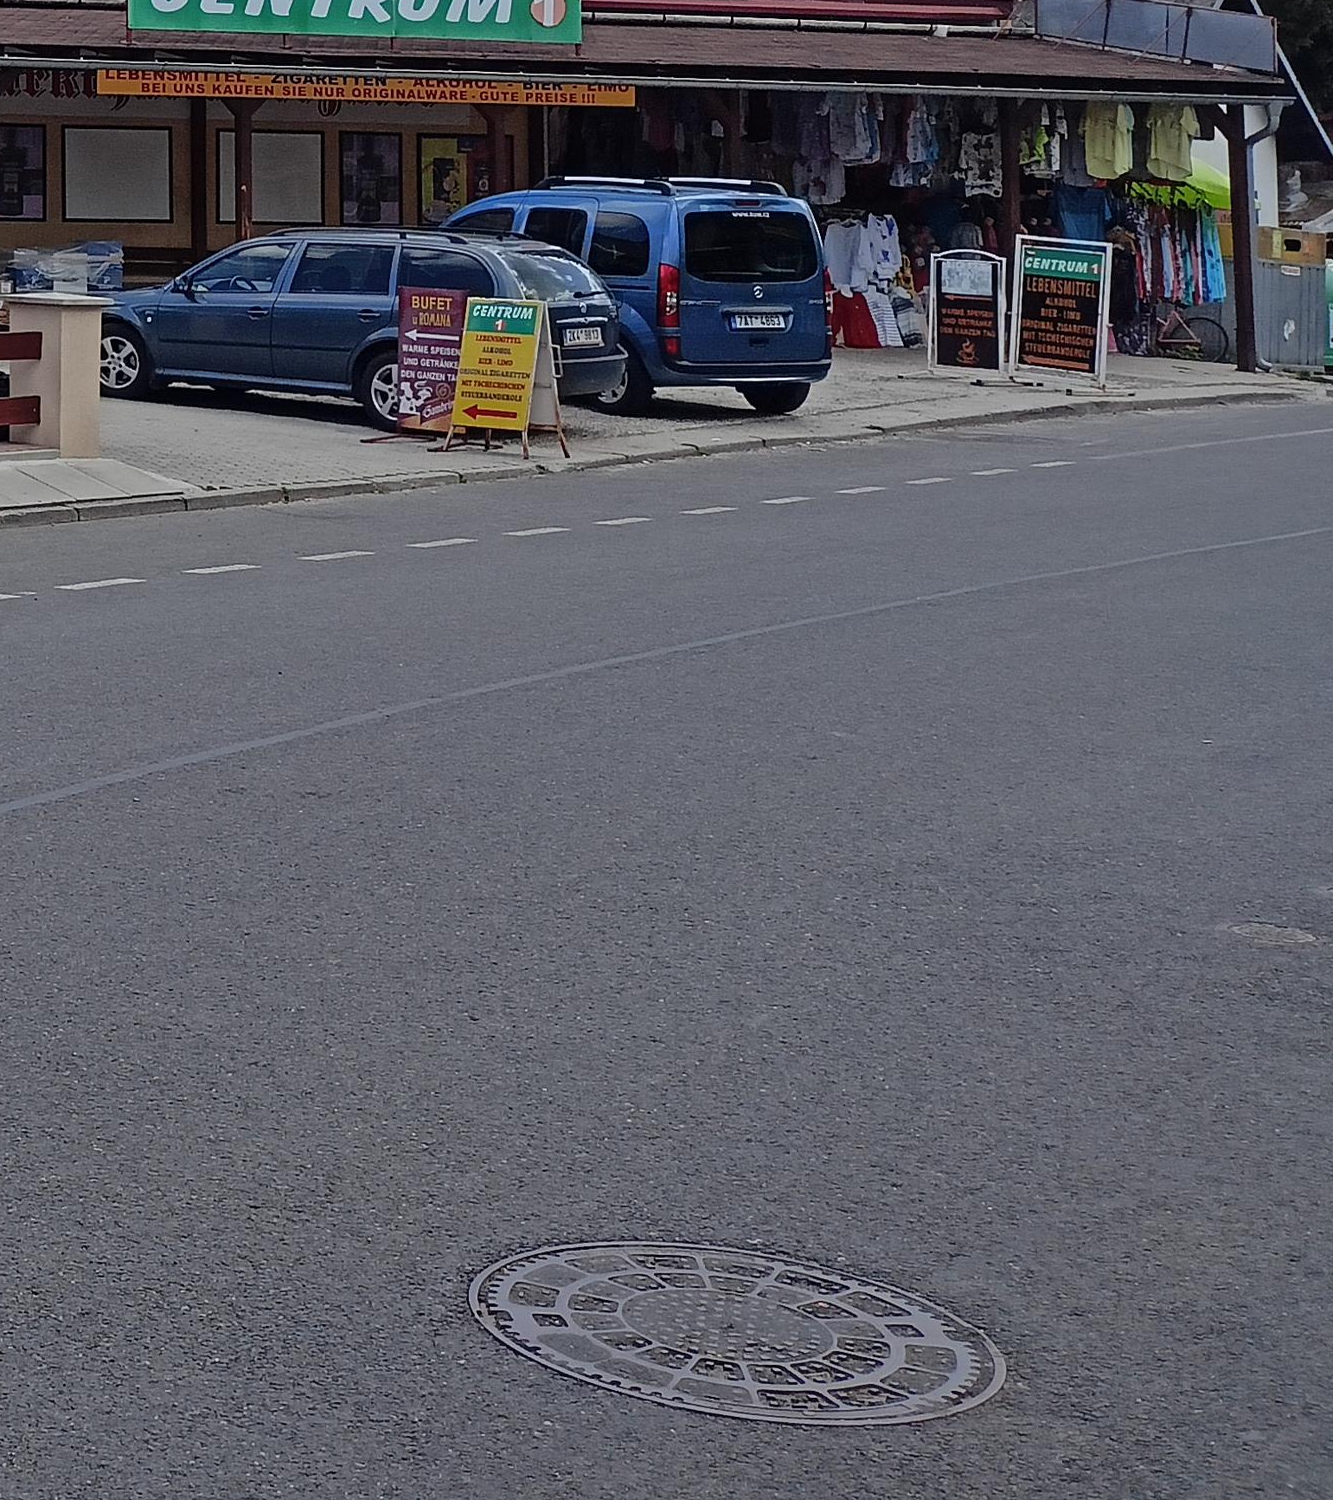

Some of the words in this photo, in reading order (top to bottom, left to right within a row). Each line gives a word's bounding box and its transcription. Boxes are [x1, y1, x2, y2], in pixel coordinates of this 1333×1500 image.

[105, 70, 247, 83] LEBENSMITTEL
[271, 74, 388, 86] ZIGARETTEN
[413, 77, 497, 89] ALKOHOL
[522, 82, 563, 91] BIER
[587, 83, 630, 92] LIMO
[141, 83, 167, 93] BEI
[174, 83, 206, 94] UNS
[213, 84, 274, 96] KAUFEN
[282, 86, 307, 97] SIE
[314, 87, 346, 98] NUR
[352, 88, 468, 101] ORIGINALWARE
[479, 91, 519, 102] GUTE
[525, 92, 577, 103] PREISE
[581, 93, 595, 104] !!!
[1025, 257, 1088, 274] CENTRUM
[1091, 263, 1098, 274] 1
[1026, 277, 1097, 298] LEBENSMITTEL
[412, 296, 453, 311] BUFET
[419, 312, 452, 327] ROMANA
[473, 305, 533, 319] CENTRUM
[495, 319, 504, 331] 1
[737, 315, 753, 326] 7AT
[403, 357, 419, 366] UND
[400, 369, 416, 379] DEN
[417, 371, 446, 381] GANZEN
[447, 373, 457, 382] TA
